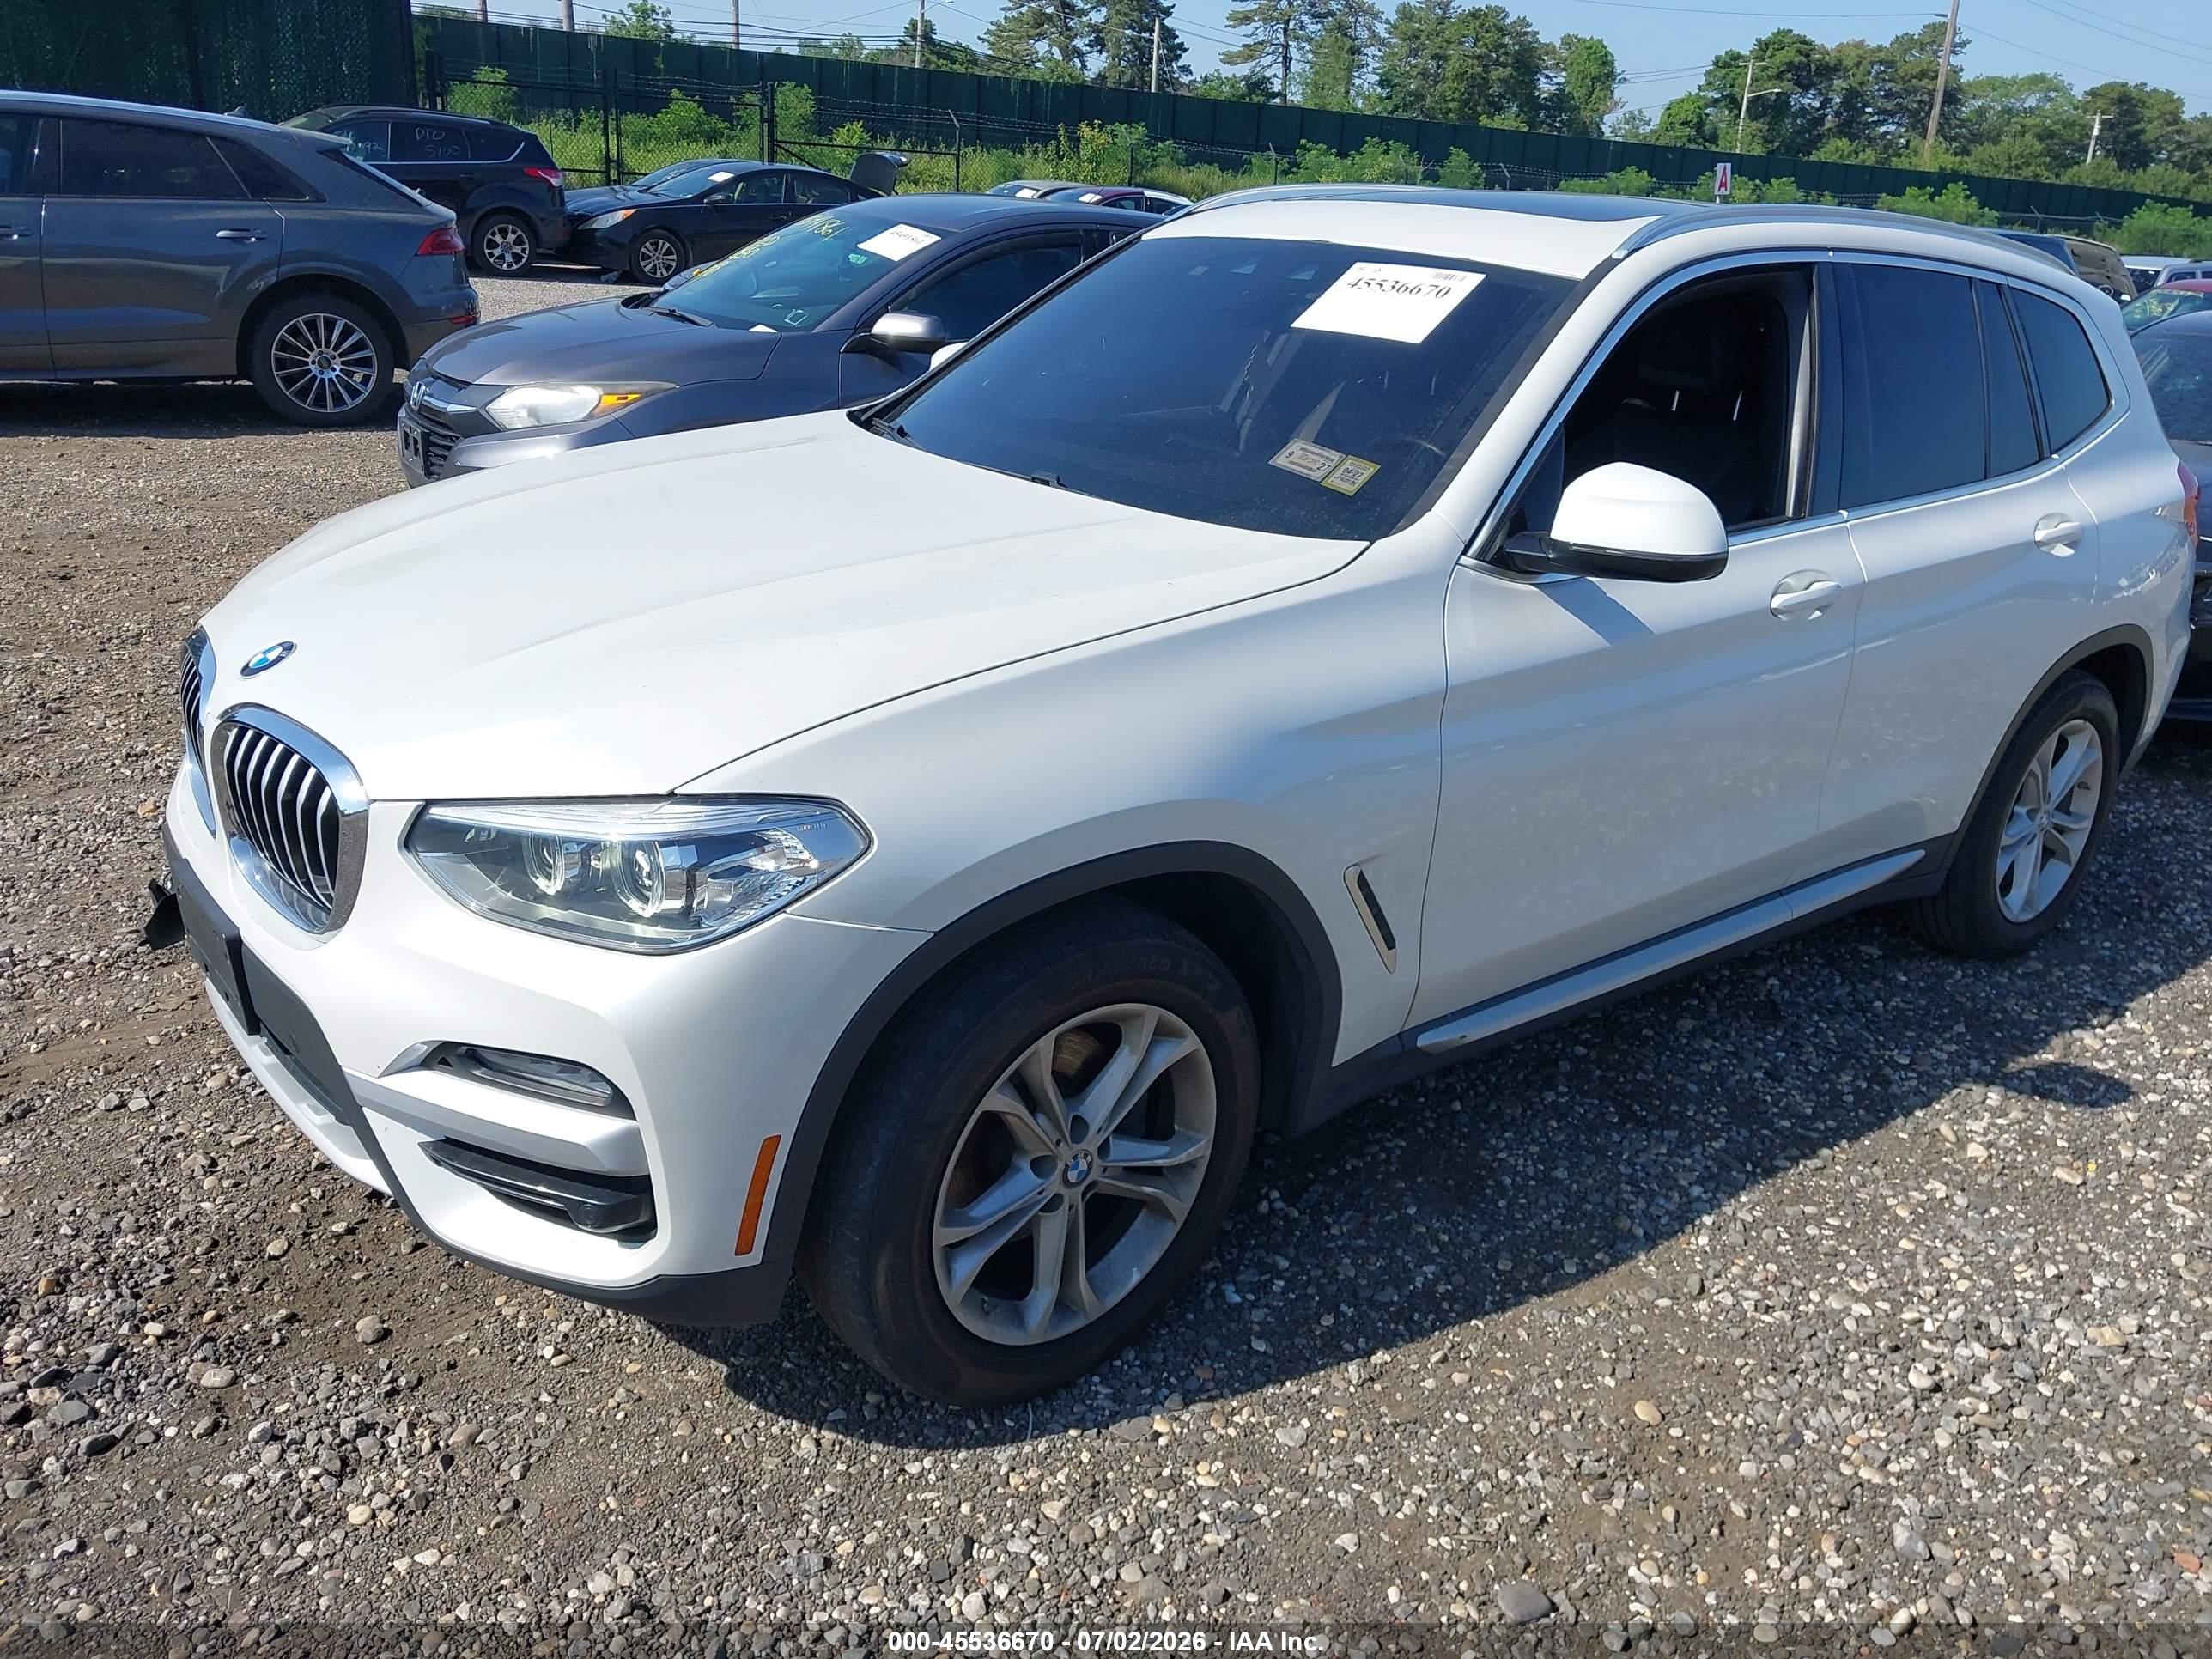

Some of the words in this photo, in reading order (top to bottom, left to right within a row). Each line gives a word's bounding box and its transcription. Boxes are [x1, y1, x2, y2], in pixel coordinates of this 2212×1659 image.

[1717, 163, 1728, 191] A
[1346, 276, 1452, 299] 45536670
[1285, 450, 1295, 459] 9
[1316, 461, 1332, 472] 27
